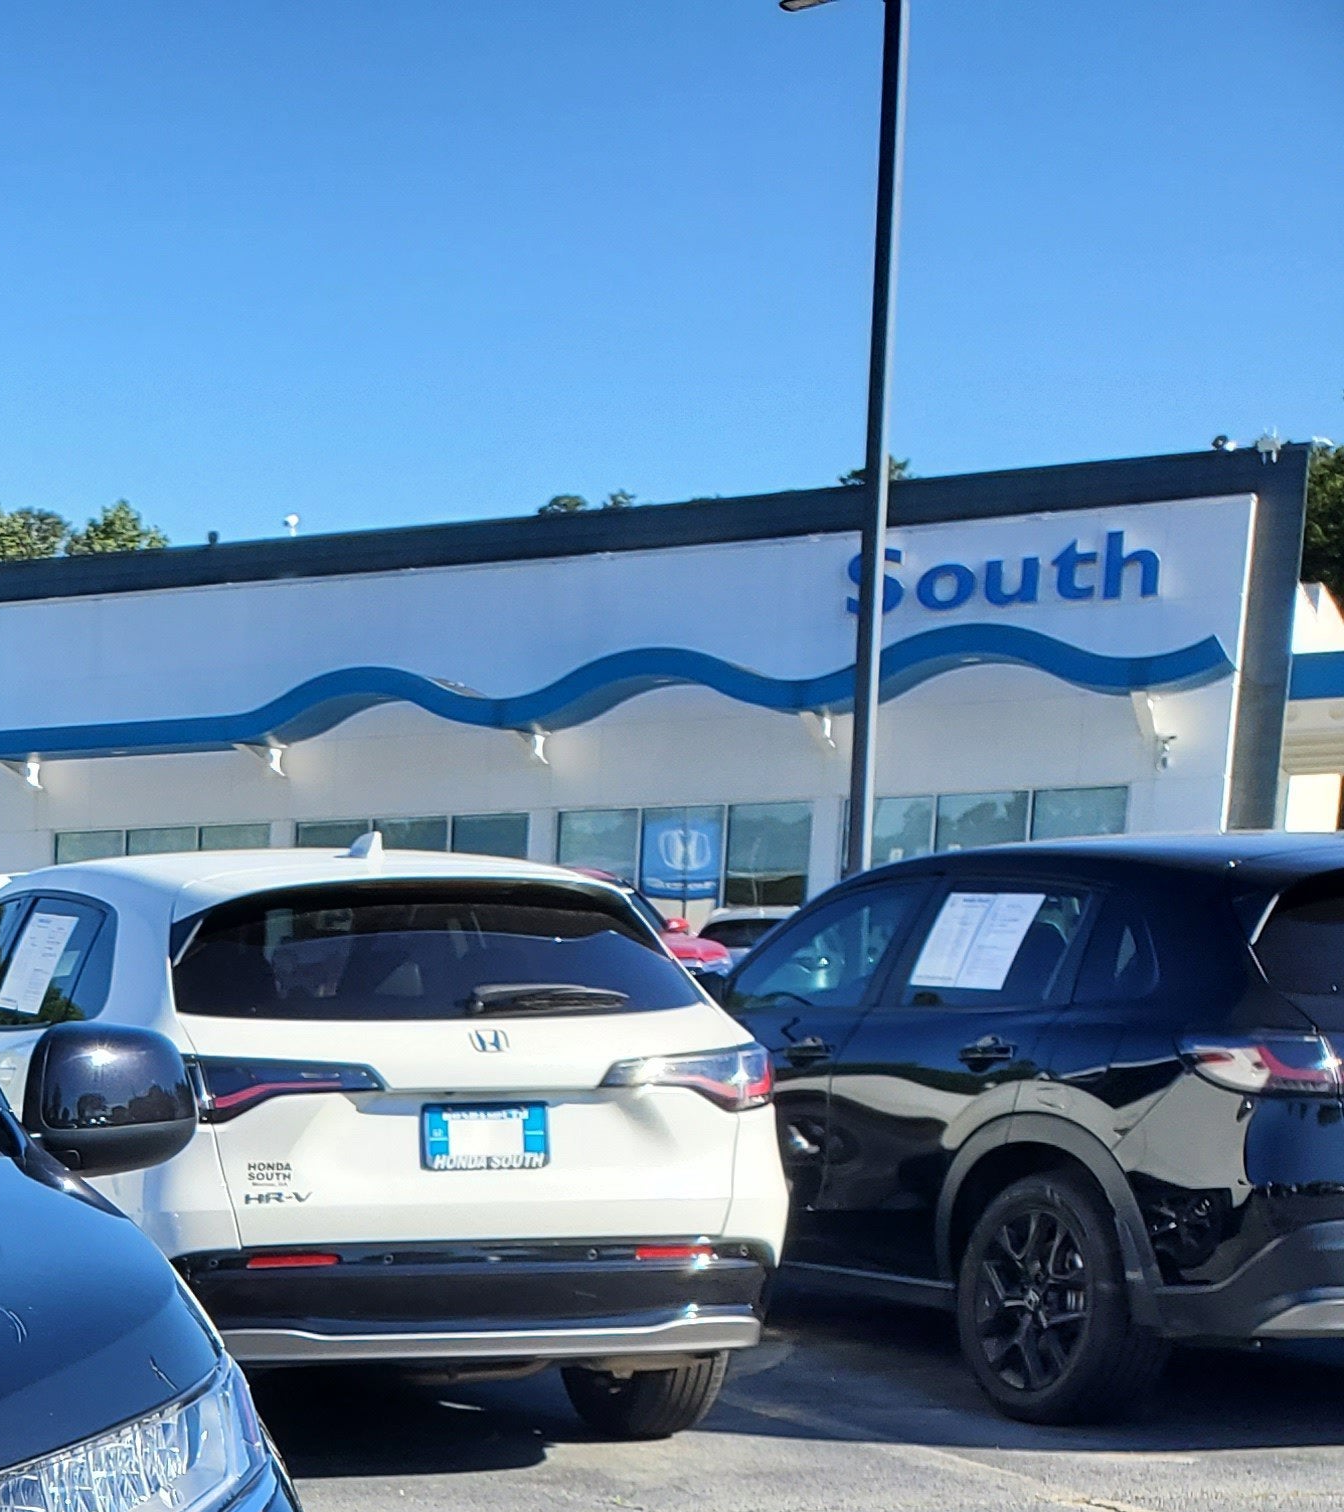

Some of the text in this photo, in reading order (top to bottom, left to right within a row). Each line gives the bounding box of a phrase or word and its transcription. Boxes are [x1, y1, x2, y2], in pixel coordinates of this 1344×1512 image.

[846, 529, 1162, 616] South
[247, 1161, 293, 1172] HONDA
[433, 1151, 545, 1170] HONDA SOUTH
[247, 1171, 292, 1182] SOUTH
[244, 1191, 314, 1205] HR-V
